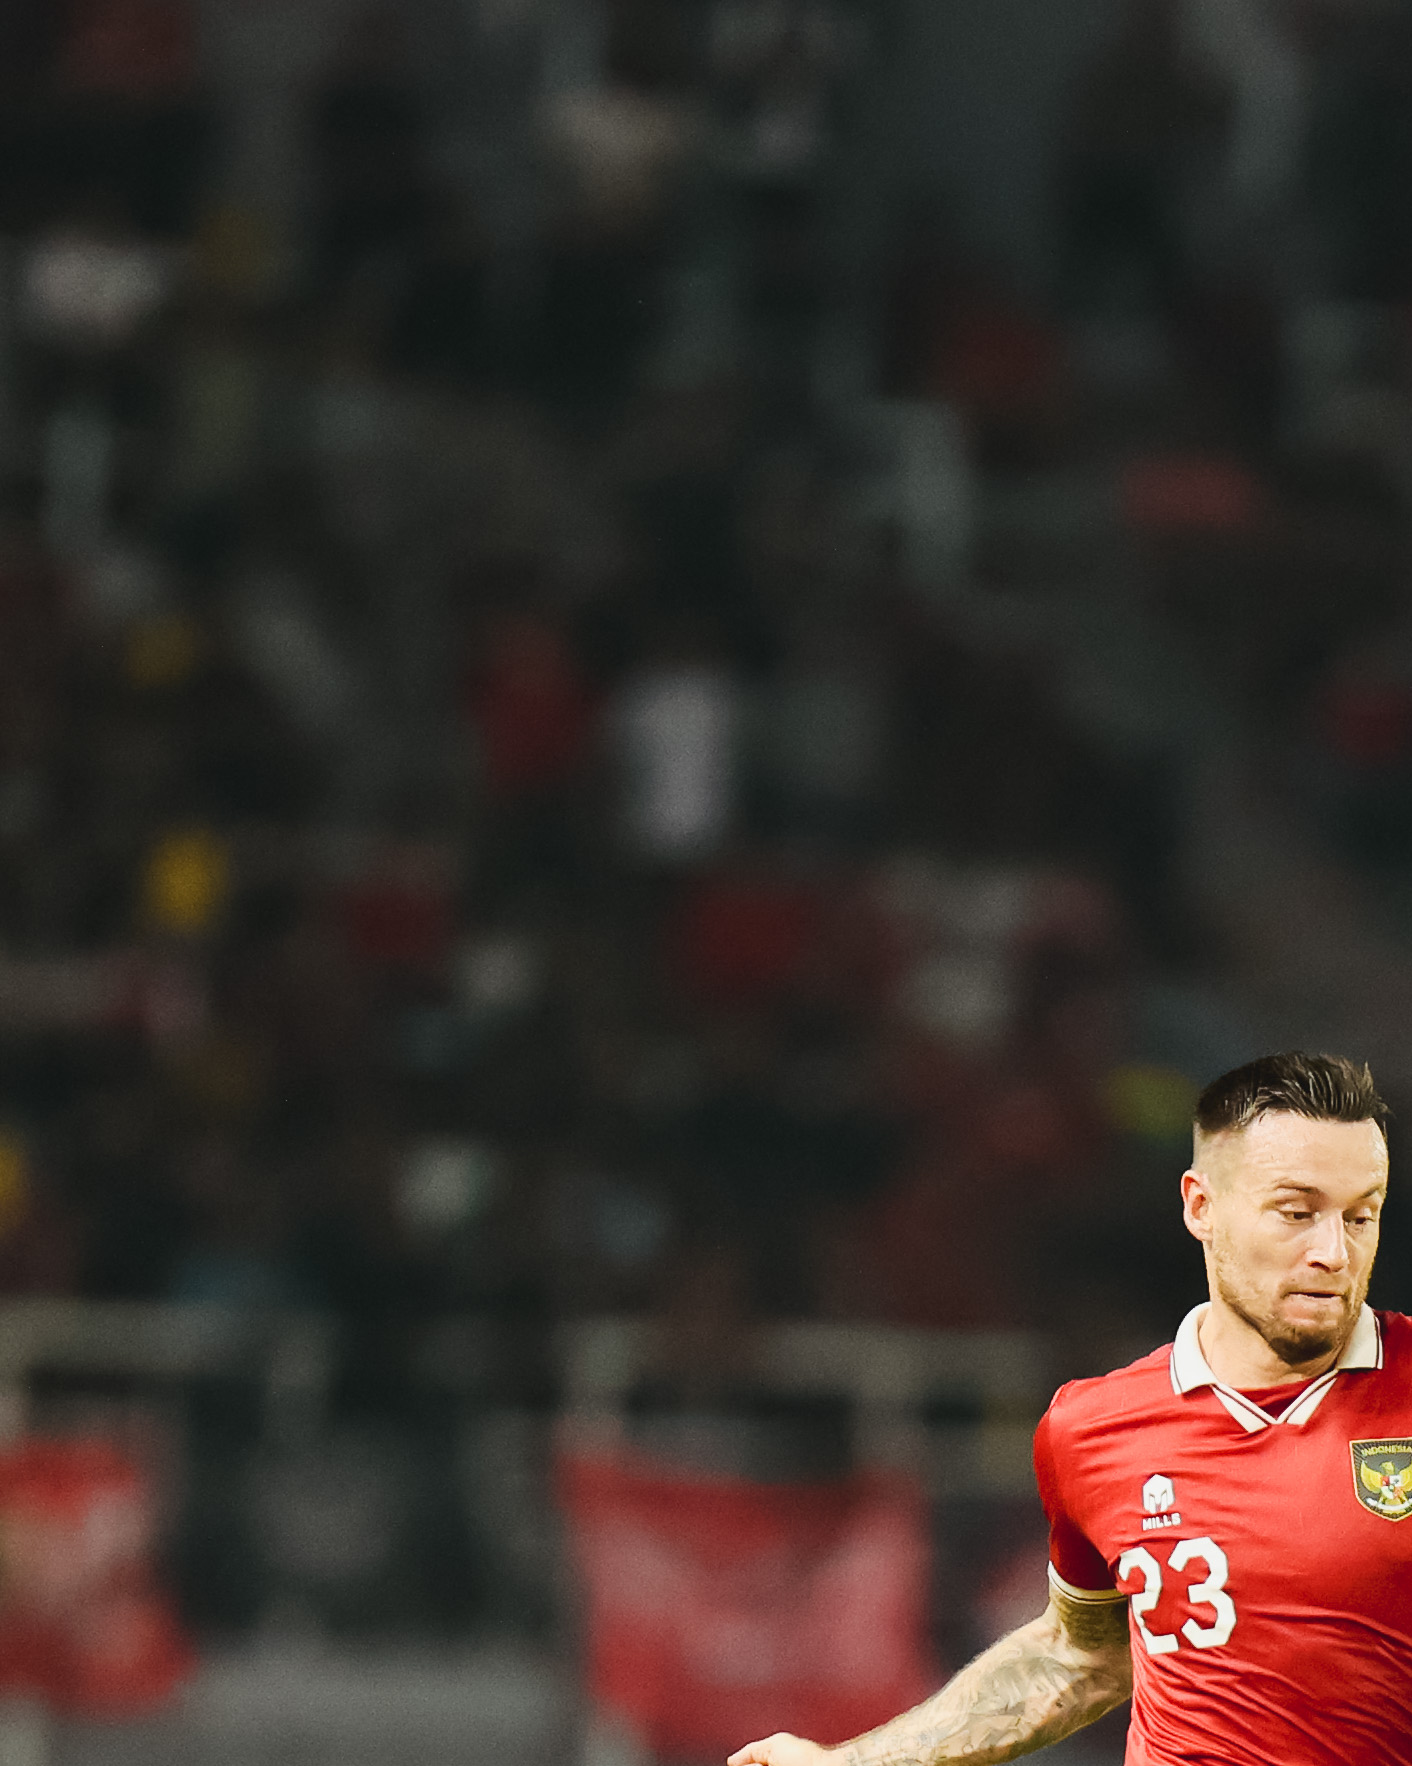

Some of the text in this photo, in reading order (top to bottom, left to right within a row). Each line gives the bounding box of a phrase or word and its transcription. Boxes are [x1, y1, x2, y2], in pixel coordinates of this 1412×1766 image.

[1360, 1445, 1412, 1457] INDONESIA
[1142, 1512, 1182, 1531] MILLS
[1118, 1536, 1237, 1655] 23
